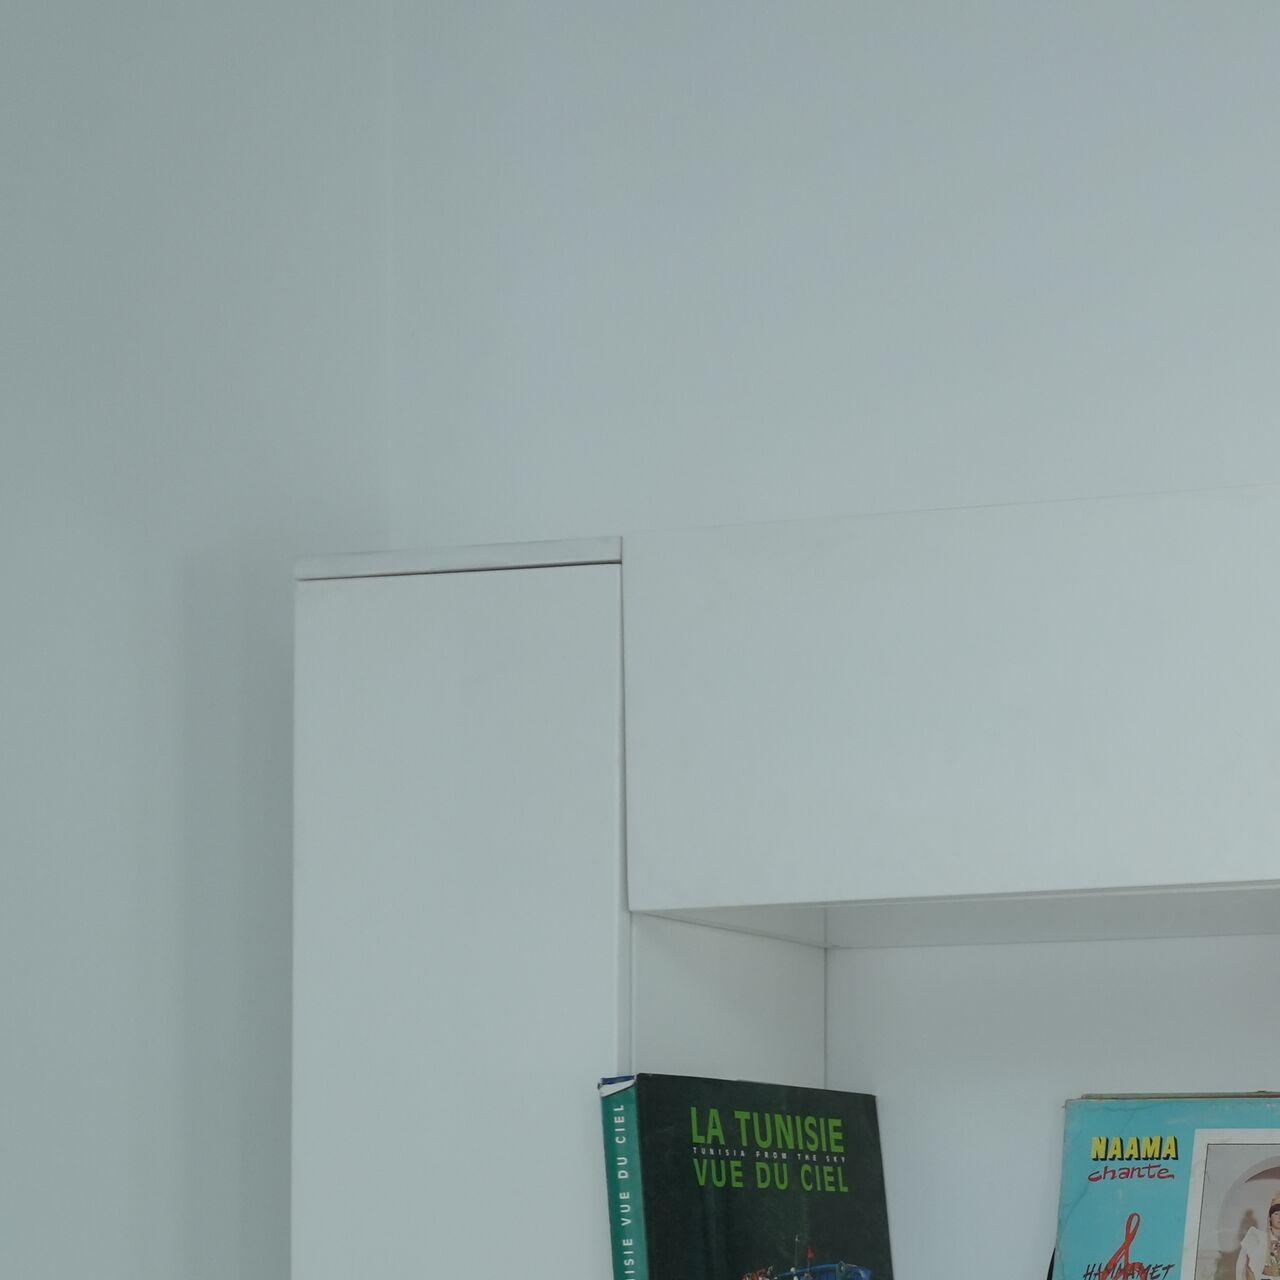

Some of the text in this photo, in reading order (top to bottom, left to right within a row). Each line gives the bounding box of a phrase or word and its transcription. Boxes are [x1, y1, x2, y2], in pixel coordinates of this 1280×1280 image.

[613, 1105, 626, 1144] CIEL
[691, 1106, 844, 1153] LA TUNISIE
[693, 1147, 746, 1157] TUNISIA
[756, 1151, 787, 1159] FROM
[797, 1153, 817, 1162] THE
[1091, 1135, 1178, 1161] NAAMA
[617, 1156, 629, 1179] DU
[693, 1158, 849, 1192] VUE DU CIEL
[1088, 1164, 1175, 1182] chante
[619, 1191, 632, 1226] VUE
